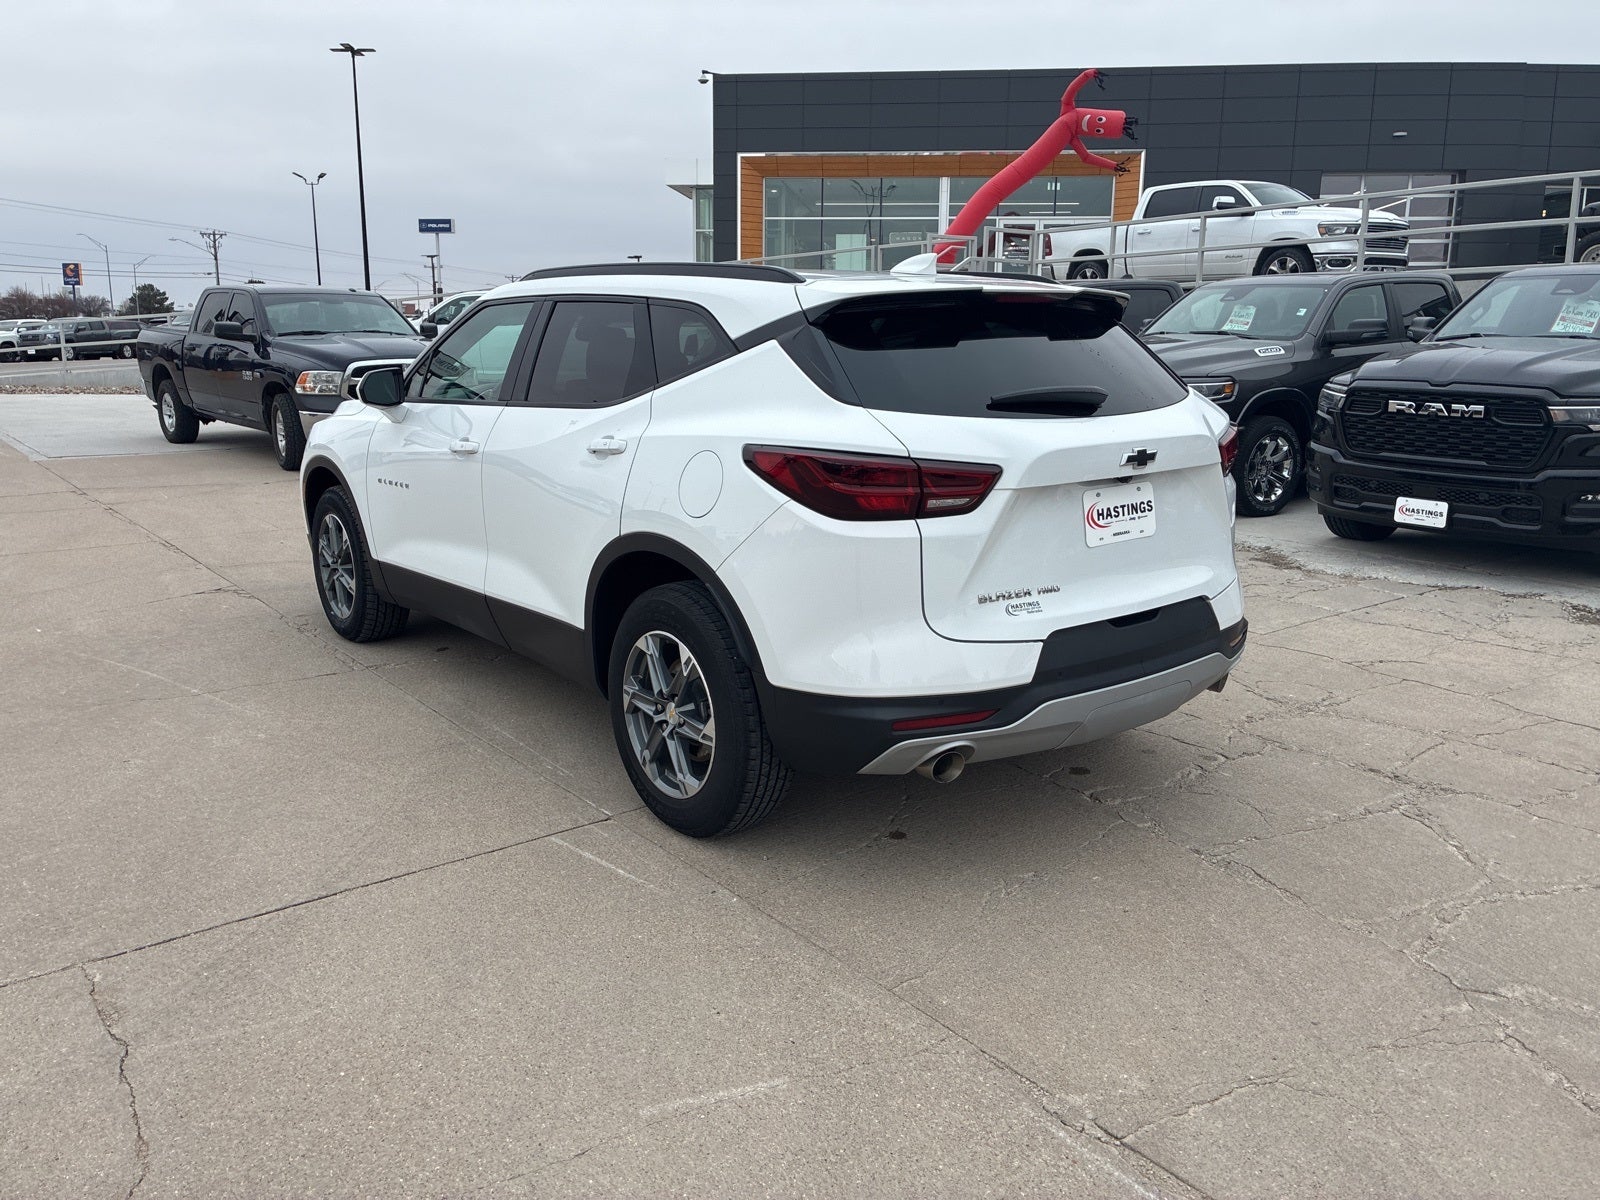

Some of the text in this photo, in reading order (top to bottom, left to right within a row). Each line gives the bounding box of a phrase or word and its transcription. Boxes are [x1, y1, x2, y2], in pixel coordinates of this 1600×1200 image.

[1387, 400, 1485, 418] RAM
[1096, 500, 1153, 521] HASTINGS
[1405, 507, 1444, 517] HASTINGS
[977, 588, 1032, 604] BLAZER
[1011, 601, 1041, 610] HASTINGS
